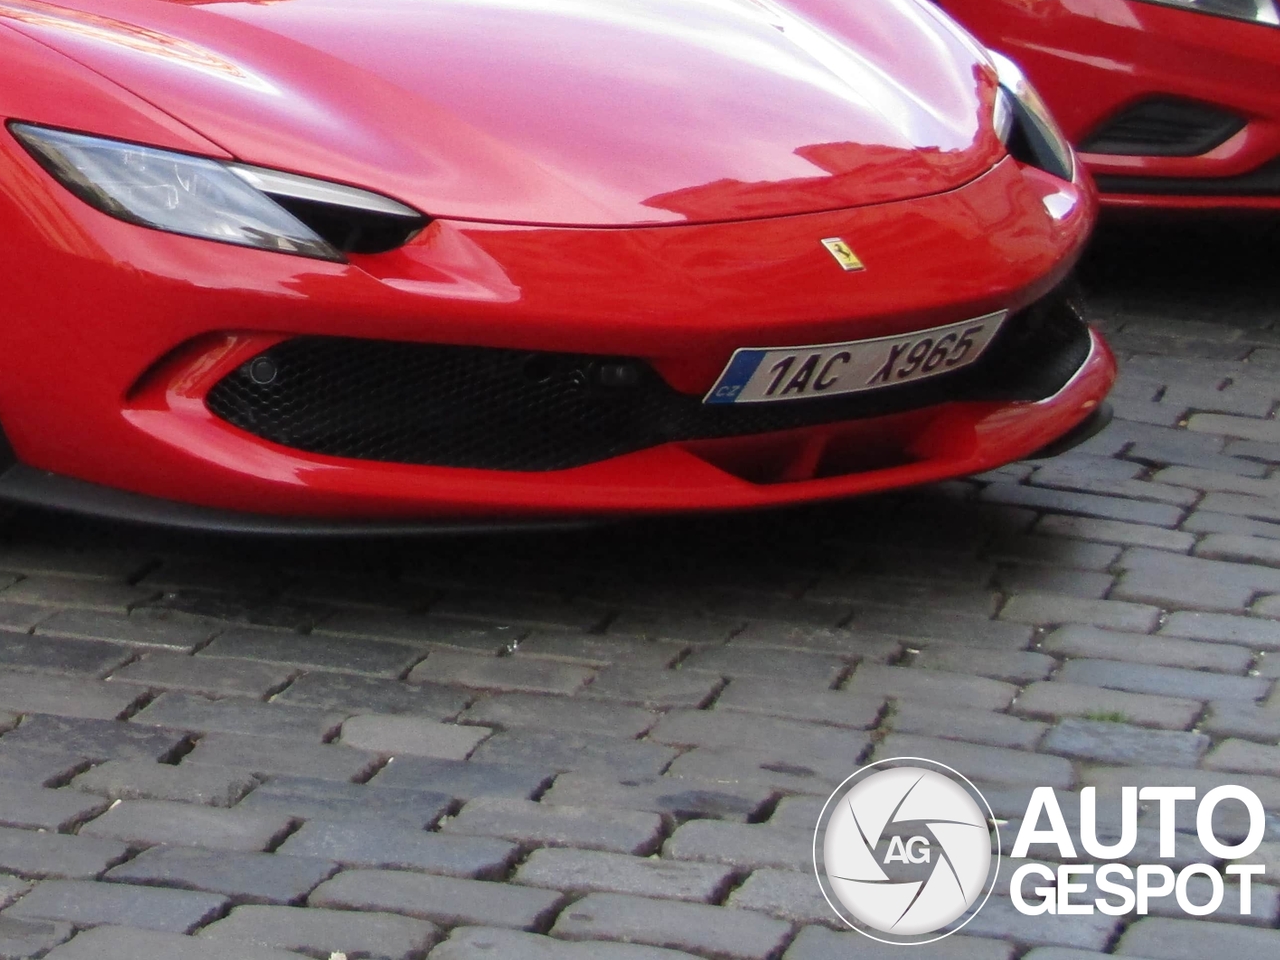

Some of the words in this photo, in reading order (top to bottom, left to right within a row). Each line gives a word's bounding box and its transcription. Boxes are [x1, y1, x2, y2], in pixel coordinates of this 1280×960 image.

[763, 351, 852, 396] 1AC
[865, 325, 985, 385] X965
[715, 384, 740, 397] CZ
